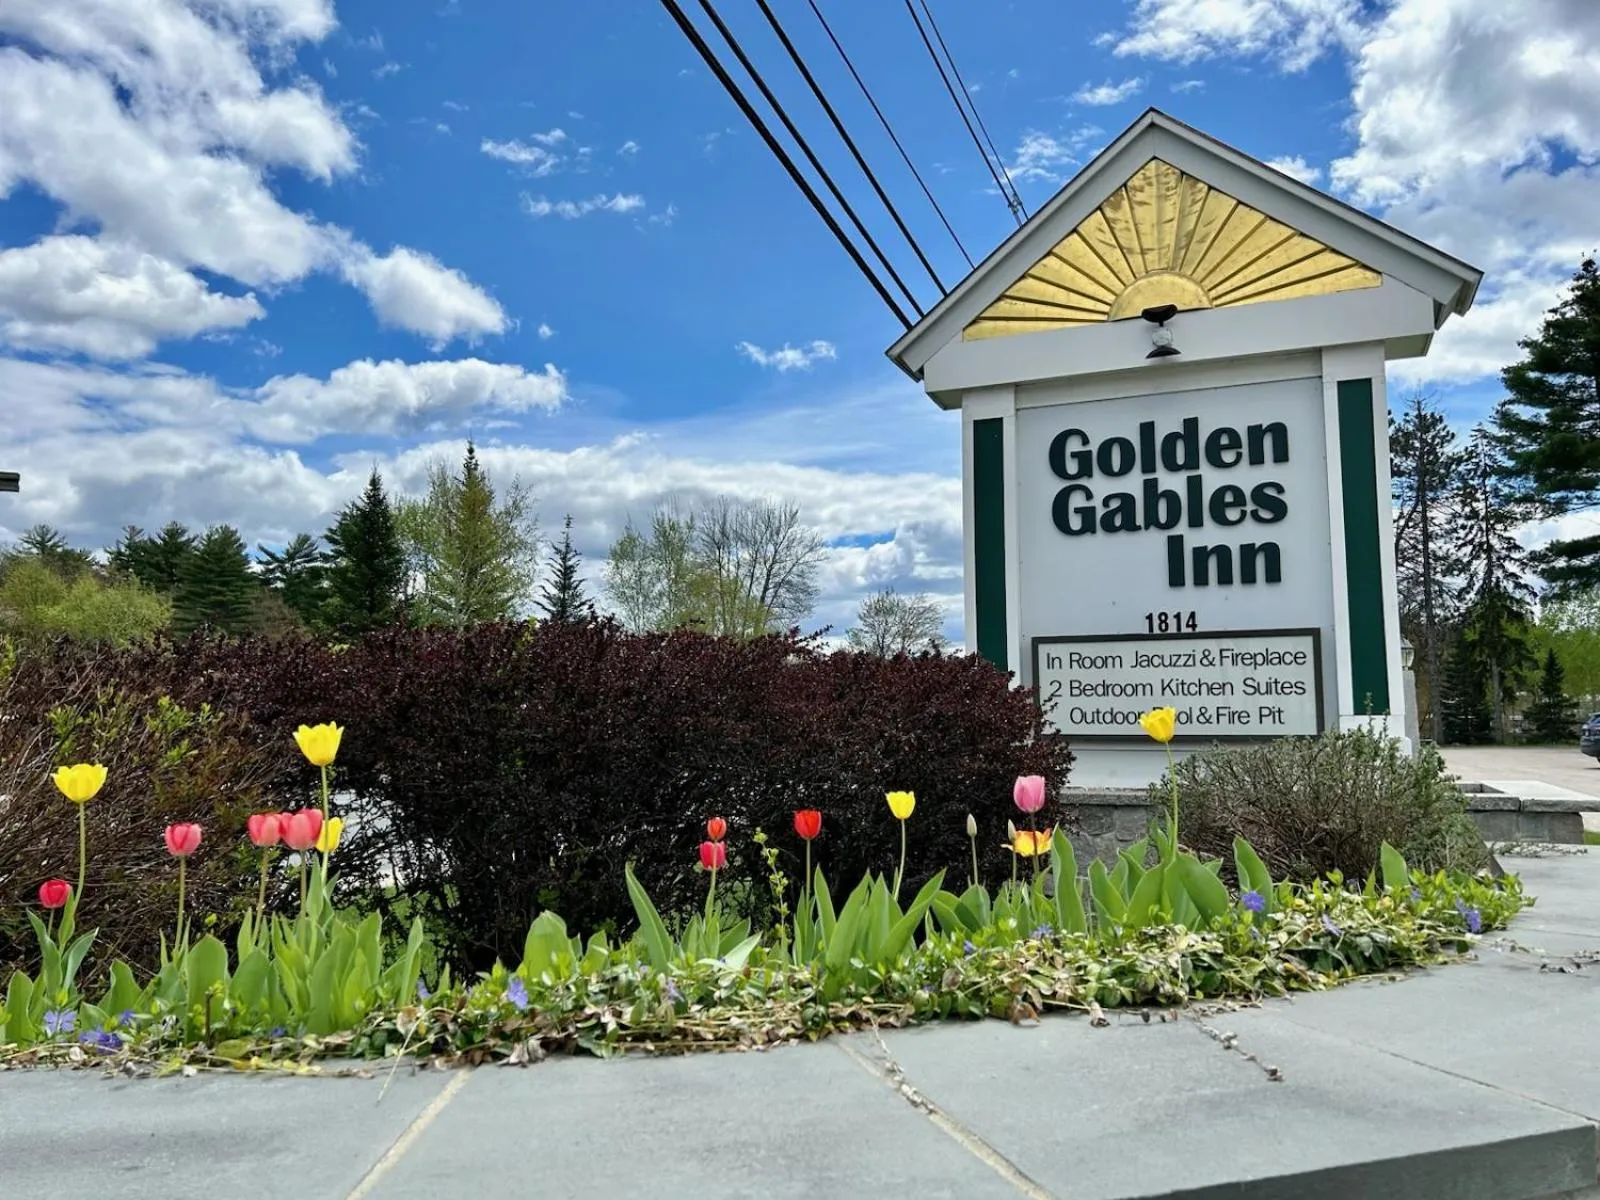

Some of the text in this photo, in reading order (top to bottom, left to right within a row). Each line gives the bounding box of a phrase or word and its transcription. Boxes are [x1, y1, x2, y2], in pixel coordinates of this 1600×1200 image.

[1049, 417, 1289, 480] Golden
[1052, 474, 1288, 536] Gables
[1167, 534, 1281, 587] Inn
[1145, 611, 1198, 633] 1814
[1046, 648, 1307, 670] In Room Jacuzzi & Fireplace
[1050, 677, 1306, 698] 2 Bedroom Kitchen Suites
[1152, 706, 1193, 725] ol
[1197, 706, 1213, 725] &
[1216, 706, 1250, 725] Fire
[1259, 706, 1285, 725] Pit
